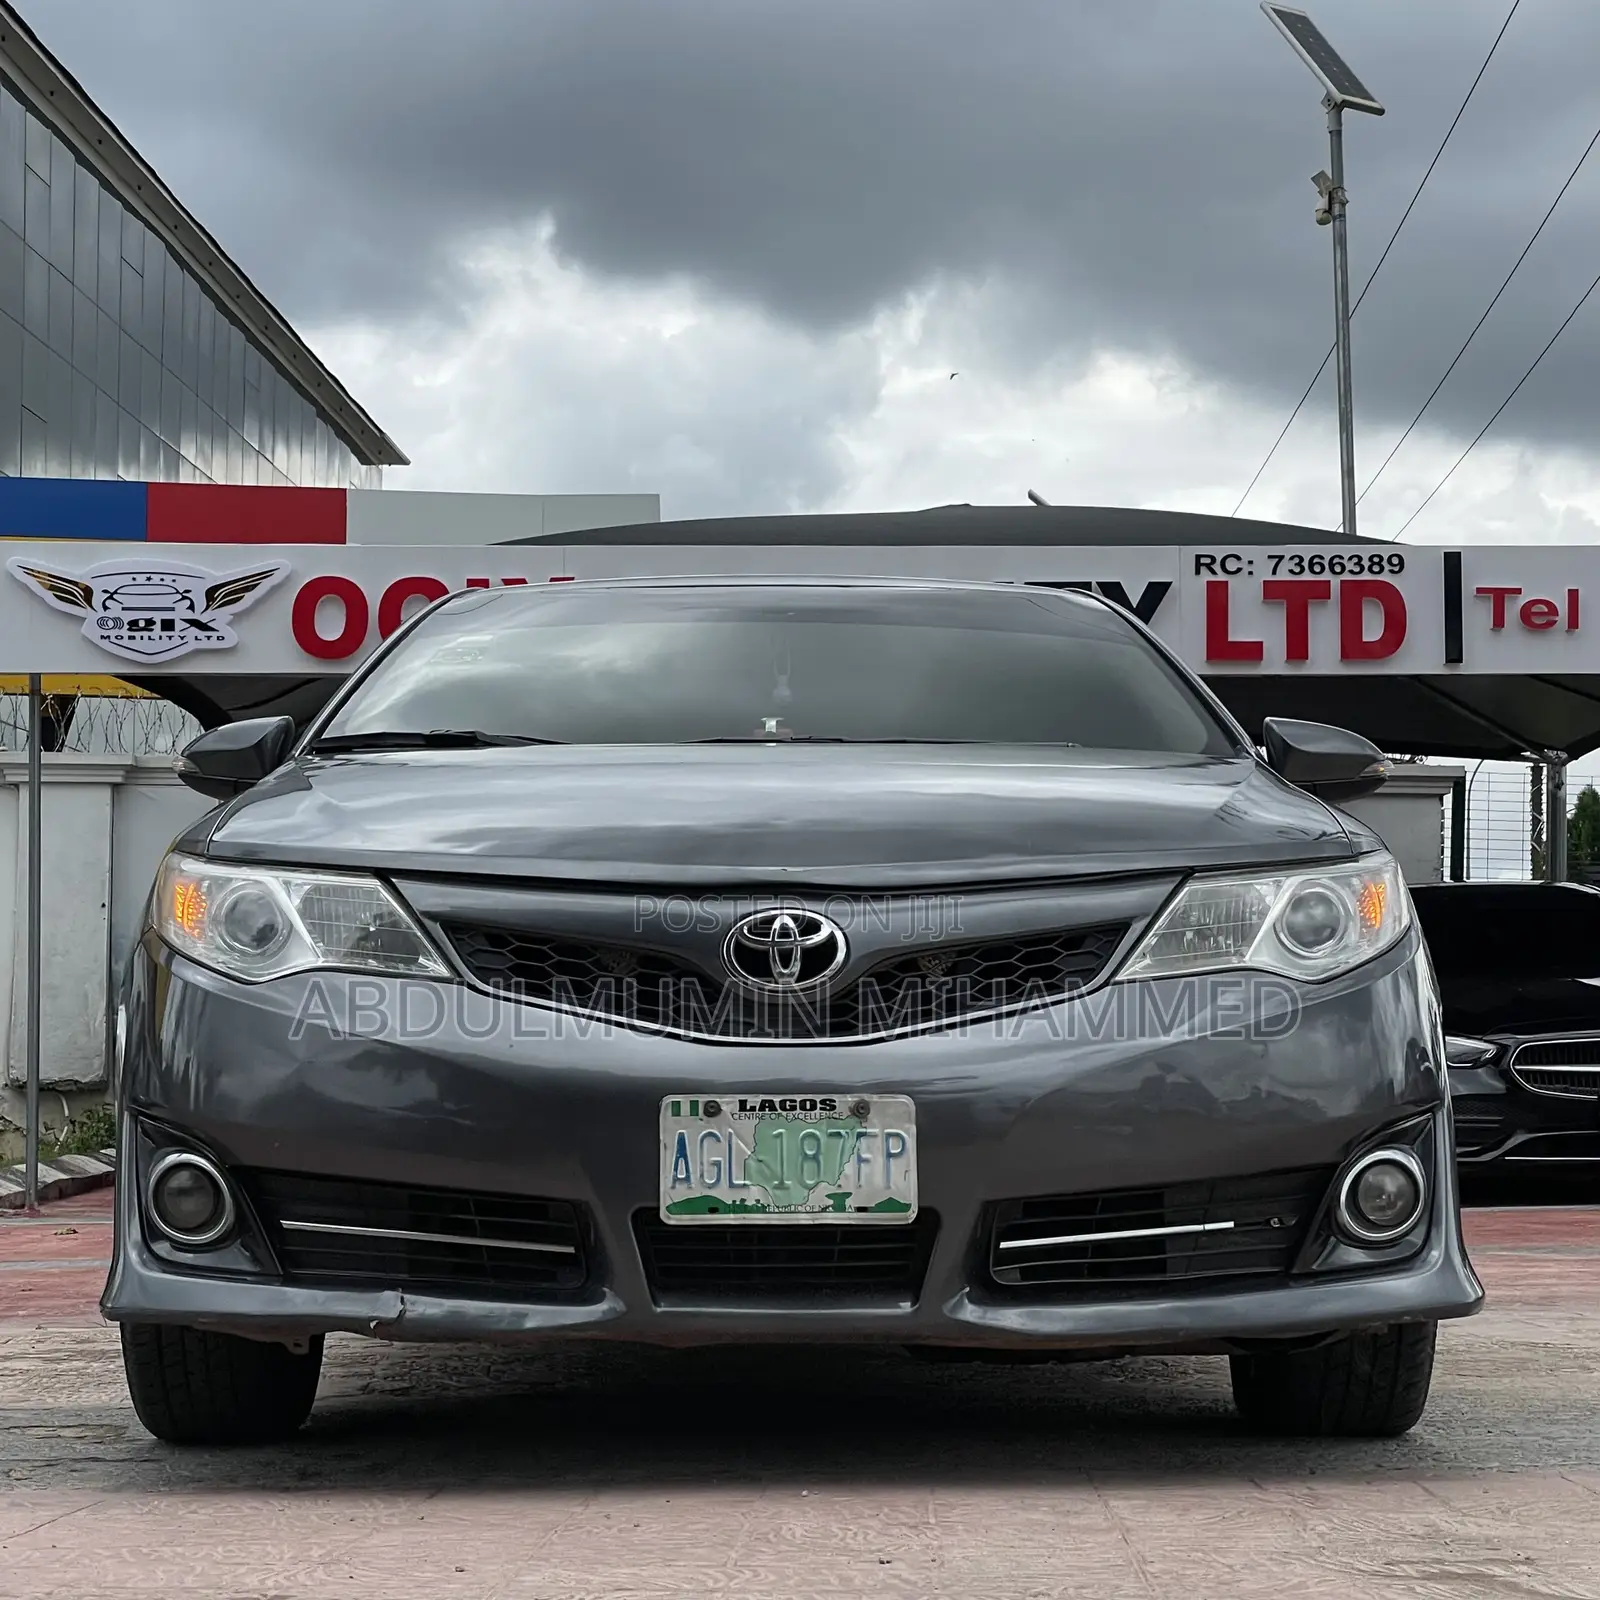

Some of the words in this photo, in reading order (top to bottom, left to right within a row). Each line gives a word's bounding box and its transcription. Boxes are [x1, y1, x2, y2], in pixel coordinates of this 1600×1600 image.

[1194, 554, 1254, 576] RC:
[1267, 554, 1405, 576] 7366389
[1475, 587, 1580, 631] Tel
[1205, 580, 1407, 661] LTD
[732, 1112, 766, 1121] CENTRE
[769, 1111, 784, 1121] OF
[786, 1111, 844, 1121] EXCELLENCE
[738, 1098, 837, 1112] LAGOS
